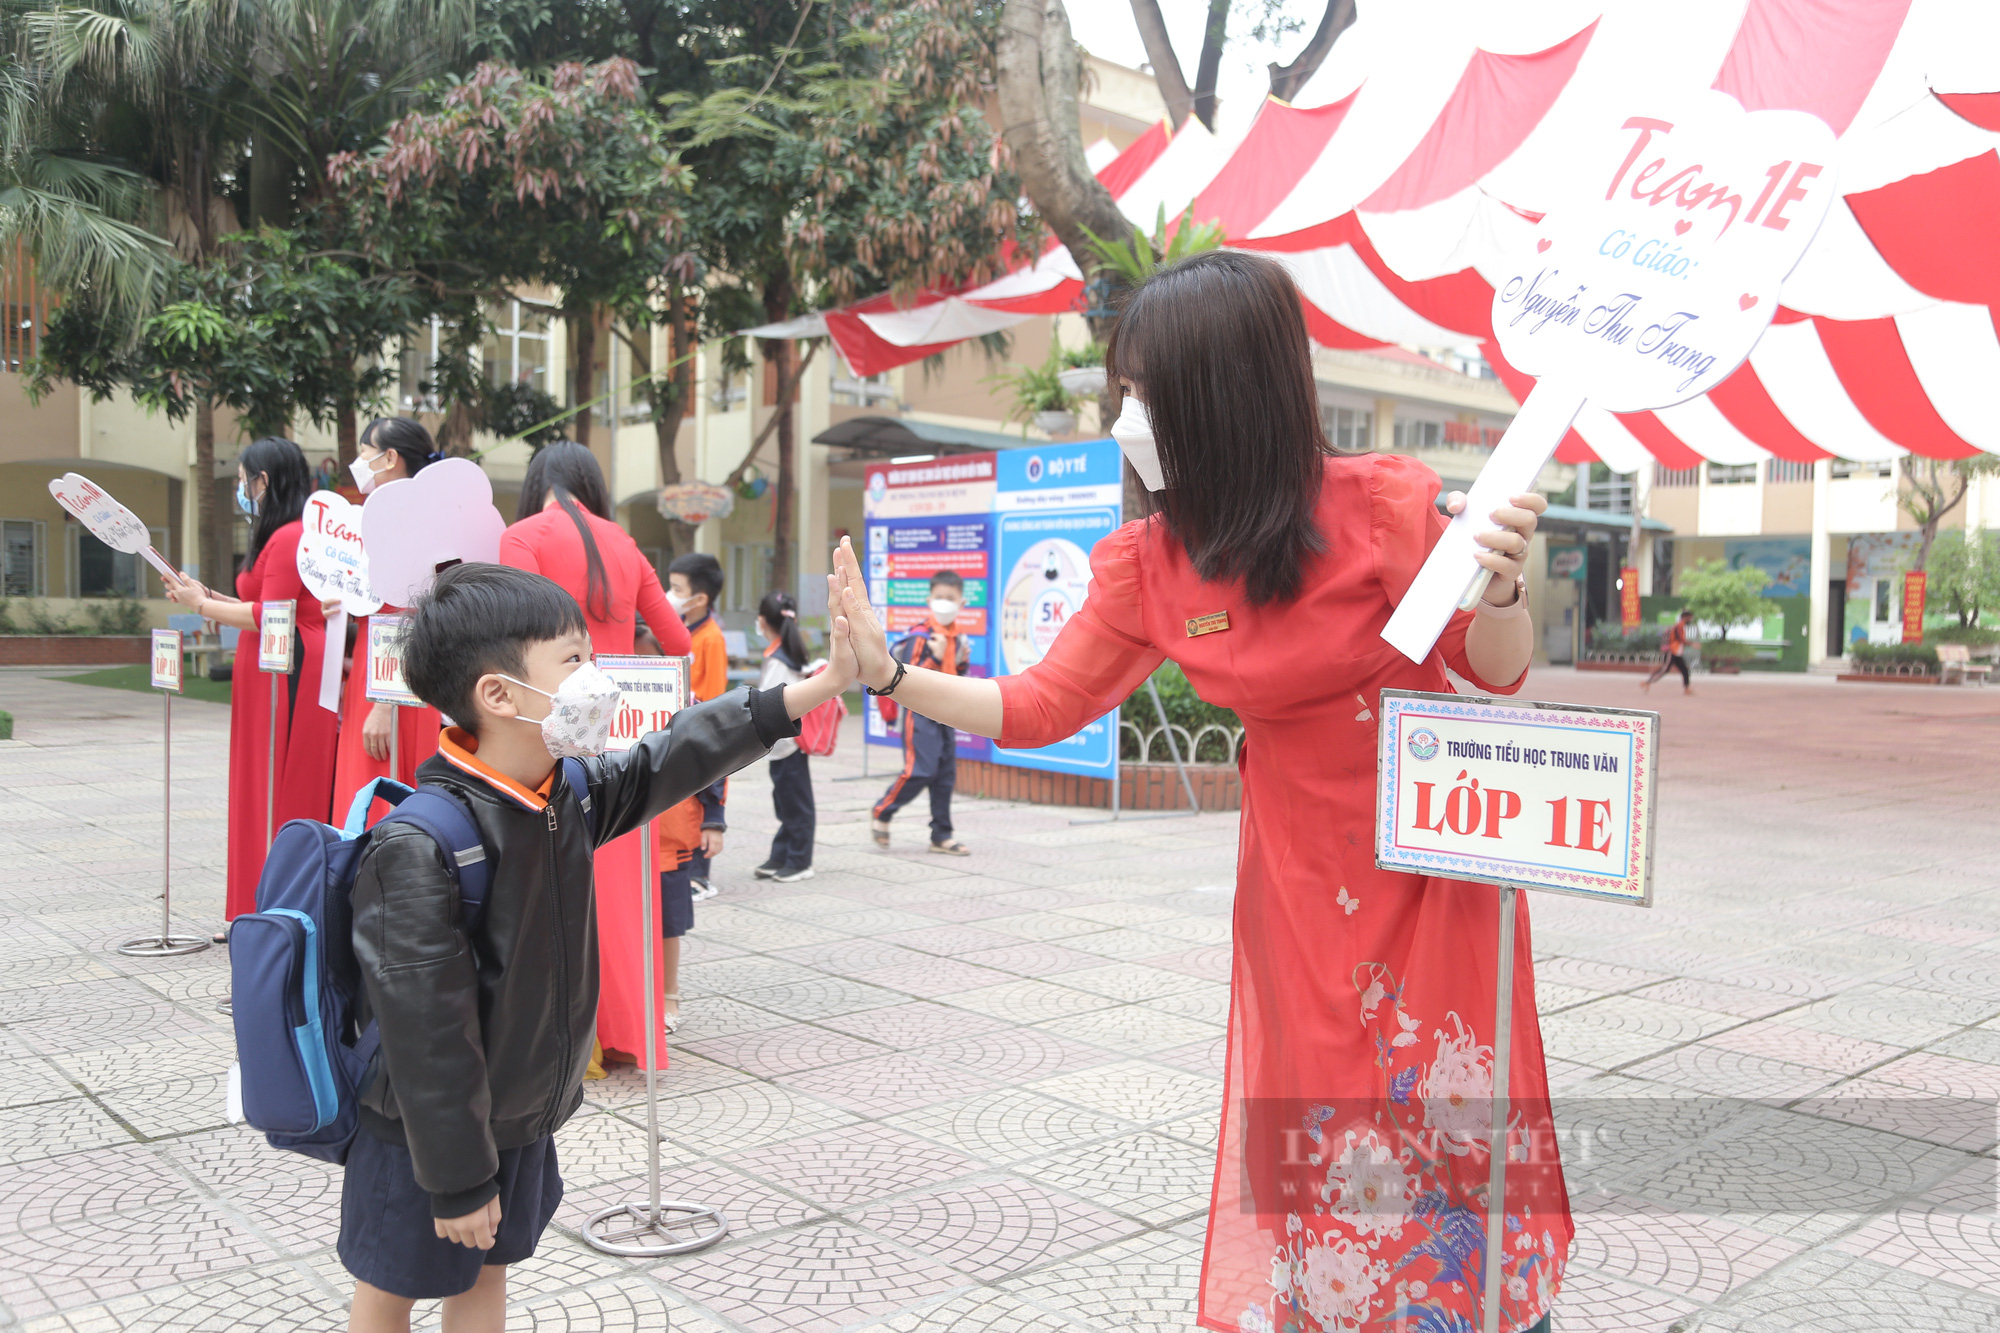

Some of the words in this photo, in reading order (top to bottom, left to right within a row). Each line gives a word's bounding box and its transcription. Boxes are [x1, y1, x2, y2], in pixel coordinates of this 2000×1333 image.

[1605, 116, 1742, 245] Team
[1743, 160, 1824, 232] 1E
[1599, 229, 1637, 257] Cô
[1632, 238, 1699, 281] Giáo:
[1501, 266, 1589, 335] Nguyễn
[1583, 293, 1643, 346] Thu
[1635, 311, 1718, 393] Trang
[311, 499, 364, 557] Team
[1041, 602, 1065, 623] 5K
[608, 698, 644, 739] LỚP
[1446, 739, 1492, 761] TRƯỜNG
[1496, 740, 1519, 763] TIỂU
[1523, 748, 1546, 769] HỌC
[1550, 751, 1590, 770] TRUNG
[1593, 755, 1618, 773] VĂN
[1411, 769, 1522, 839] LỚP
[1544, 795, 1613, 858] 1E
